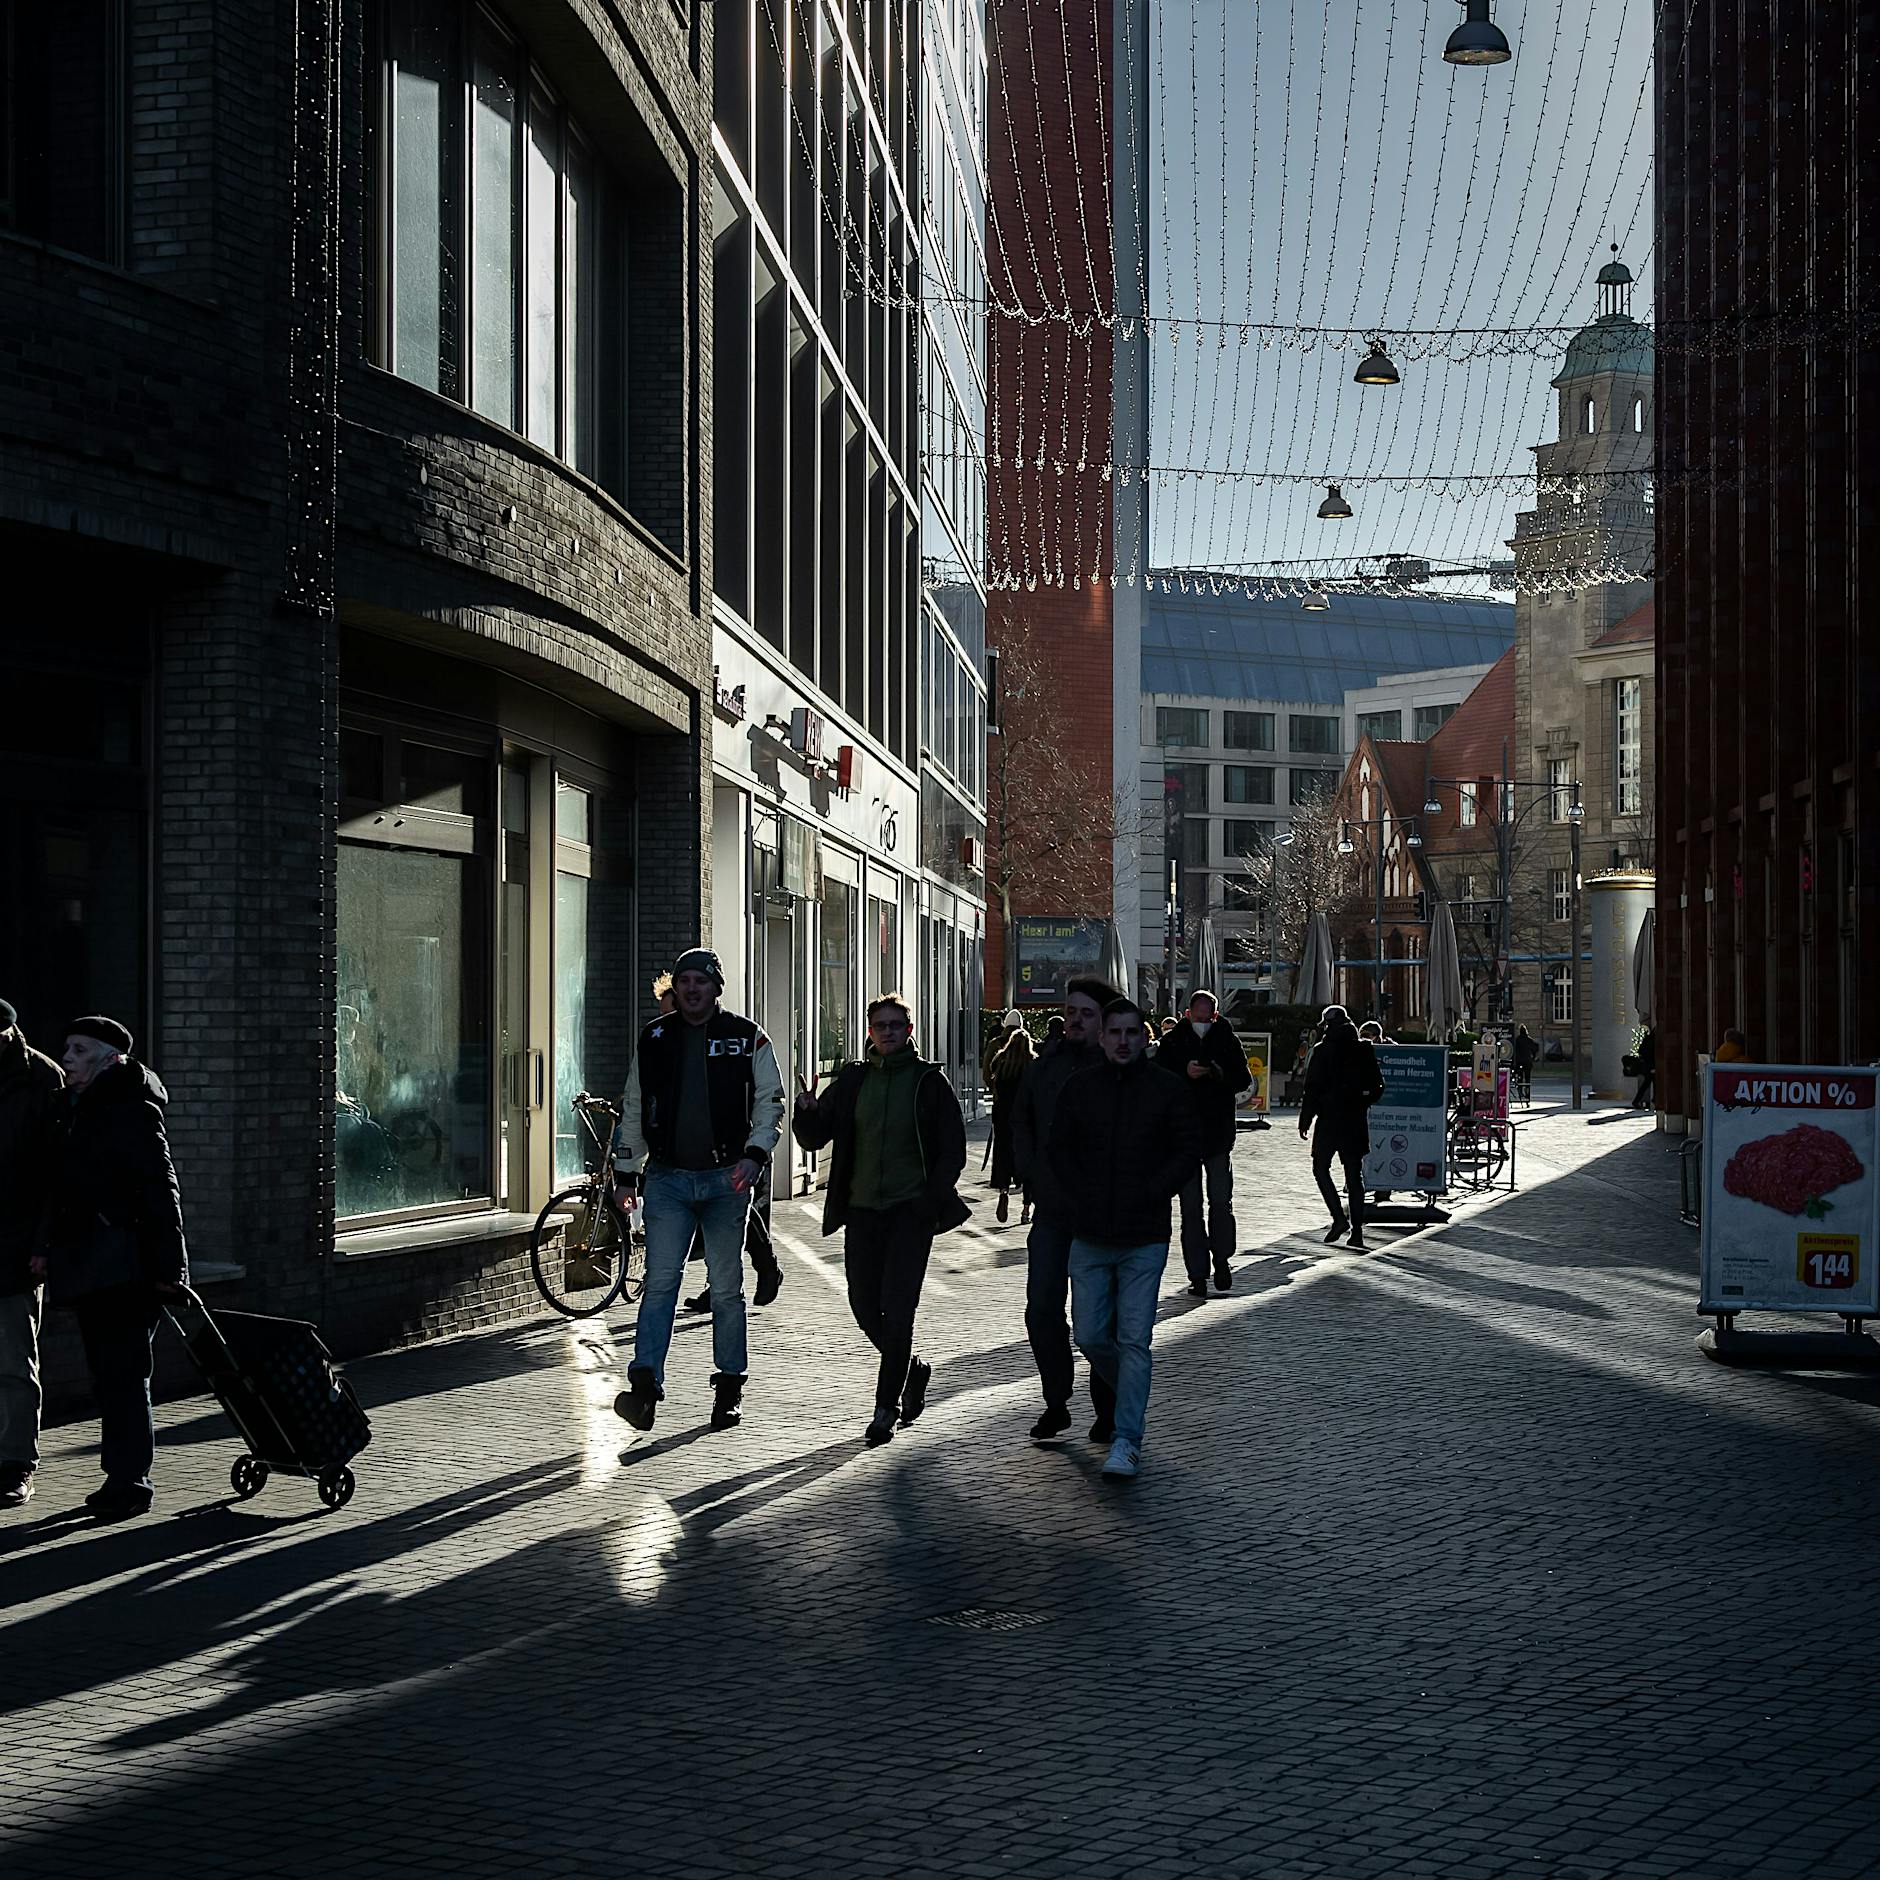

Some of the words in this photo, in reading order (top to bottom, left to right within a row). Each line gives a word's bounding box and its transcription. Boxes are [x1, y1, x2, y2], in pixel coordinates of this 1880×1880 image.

[1021, 924, 1047, 937] Hear
[1382, 1055, 1426, 1066] Gesundheit
[1393, 1069, 1405, 1077] am
[1407, 1067, 1435, 1078] Herzen
[1734, 1080, 1821, 1104] AKTION
[1827, 1082, 1857, 1106] %
[1368, 1112, 1394, 1121] kaufen
[1409, 1113, 1423, 1122] mit
